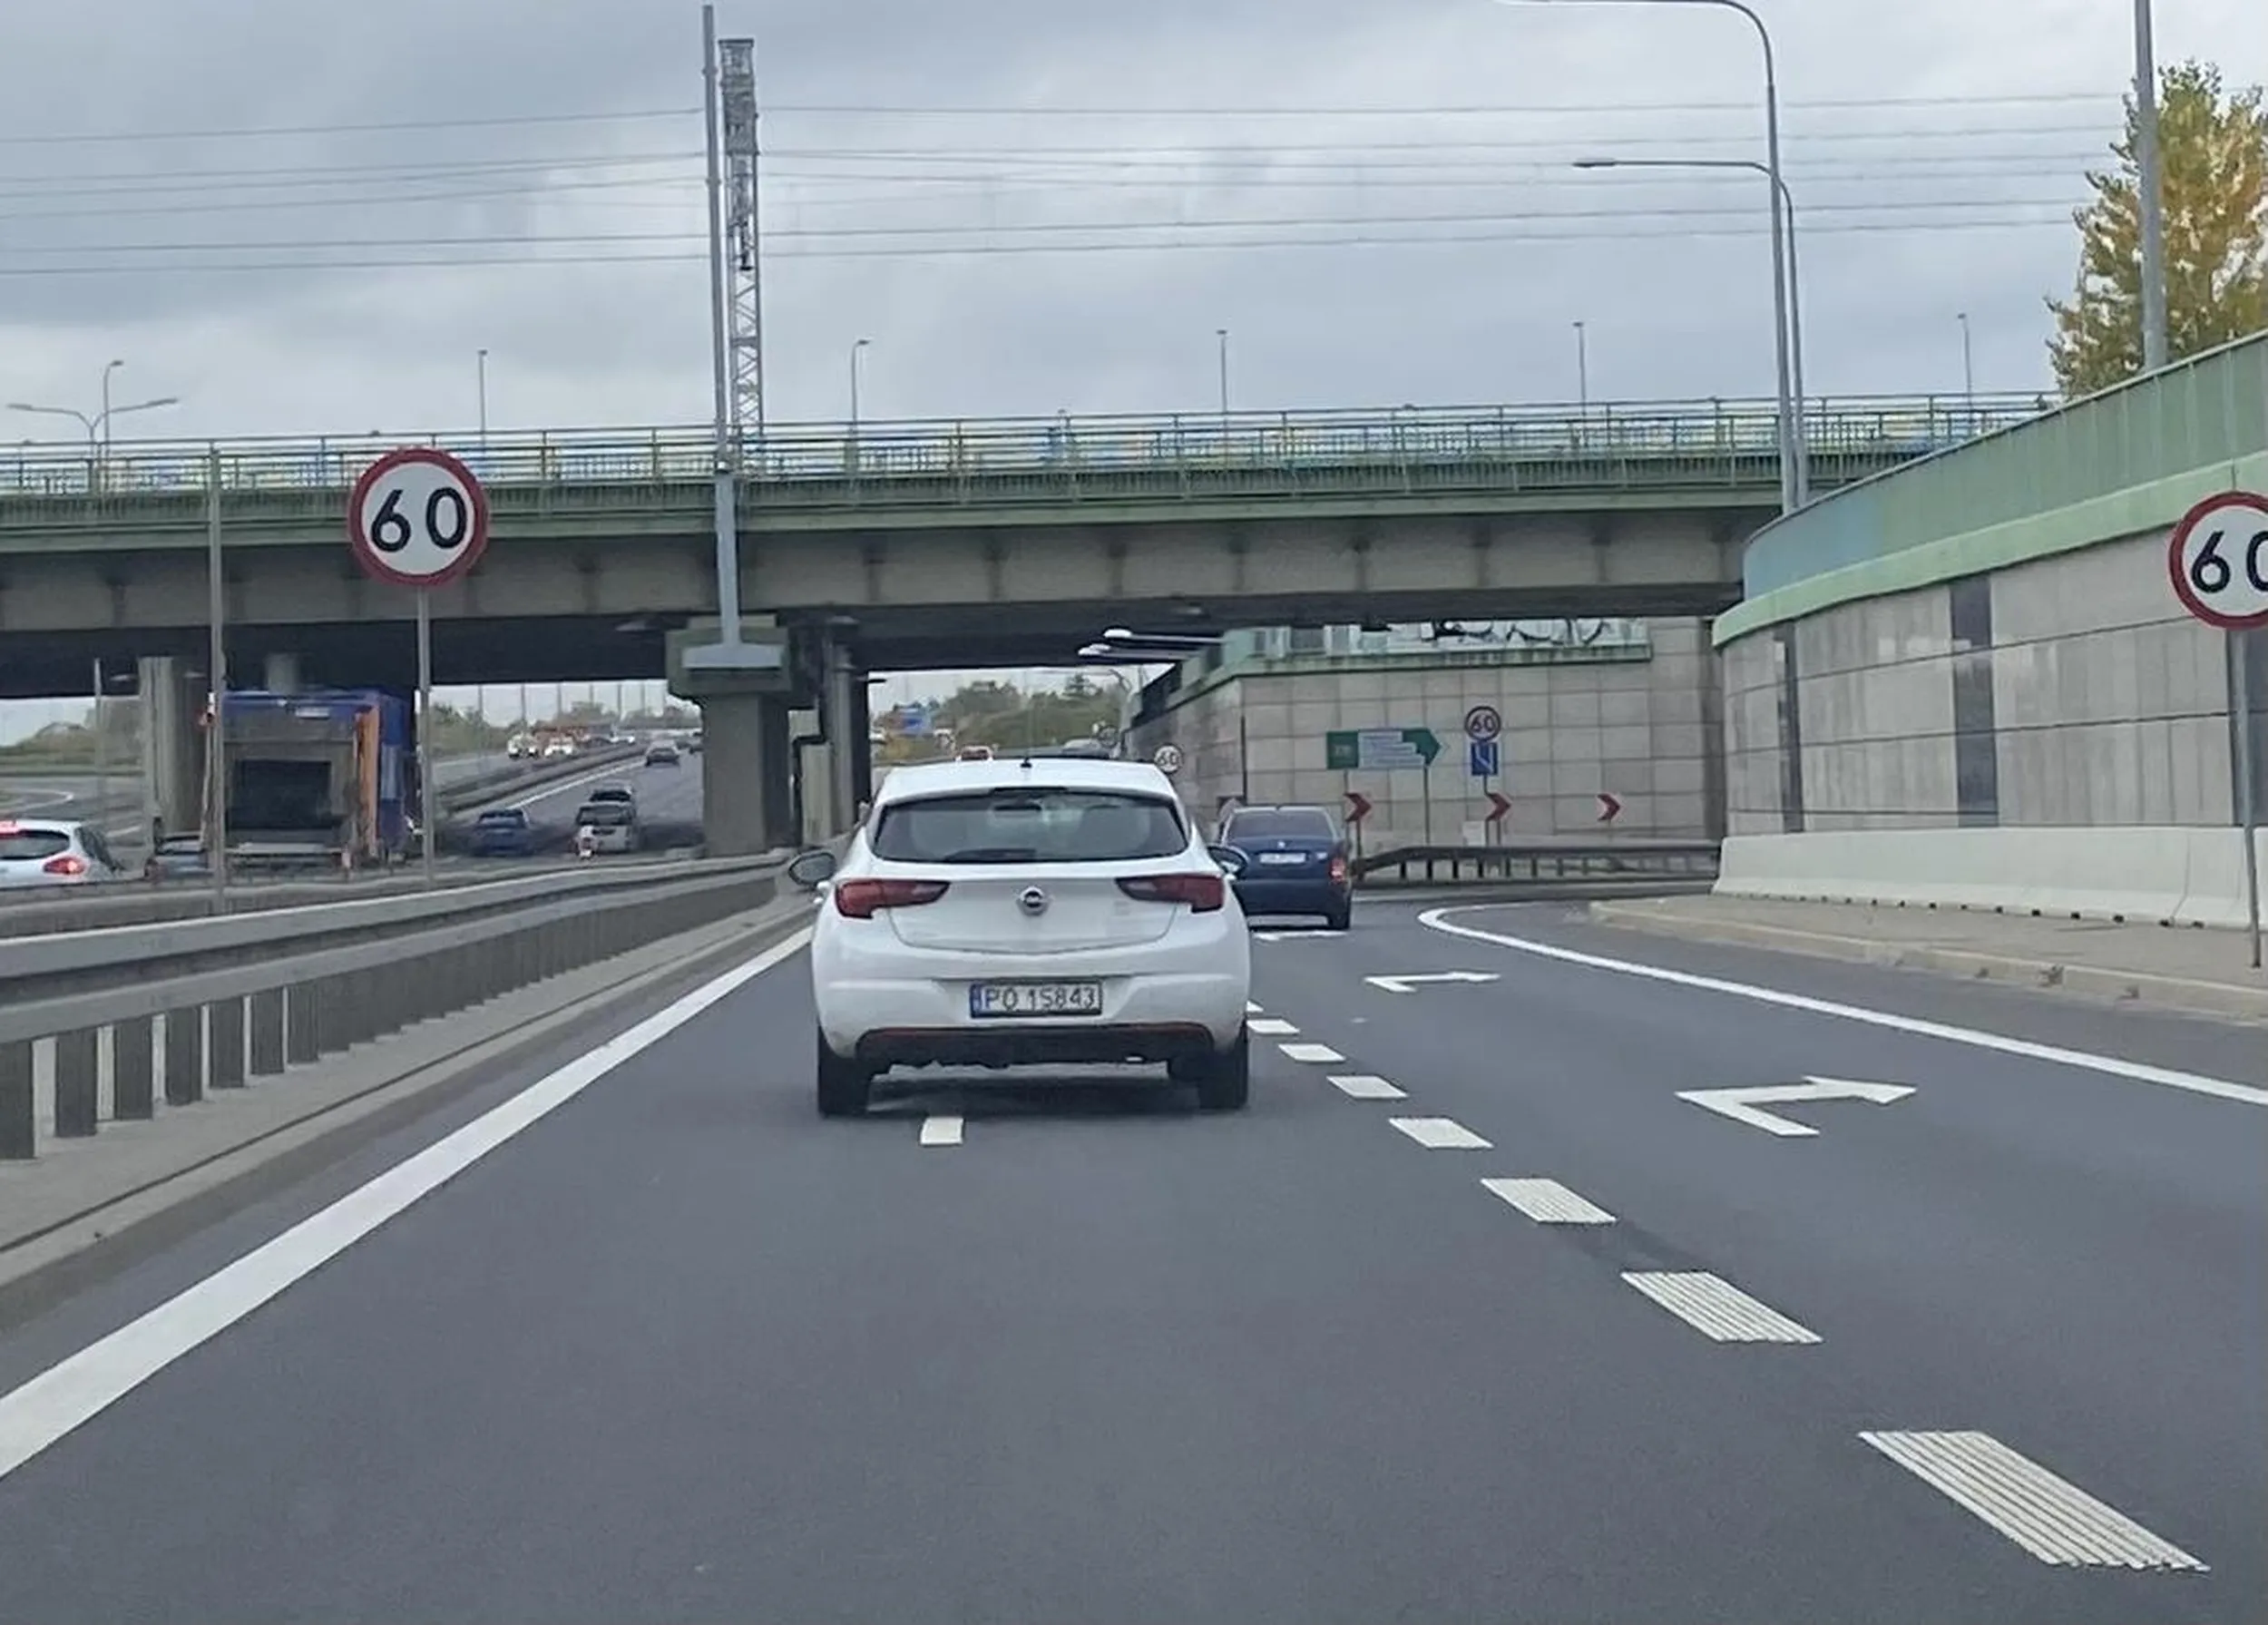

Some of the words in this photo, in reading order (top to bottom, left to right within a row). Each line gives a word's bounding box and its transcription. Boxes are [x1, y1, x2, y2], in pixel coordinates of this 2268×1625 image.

[371, 487, 467, 553] 60
[1471, 715, 1495, 732] 60
[1157, 751, 1180, 765] 60
[985, 987, 1019, 1011] PO
